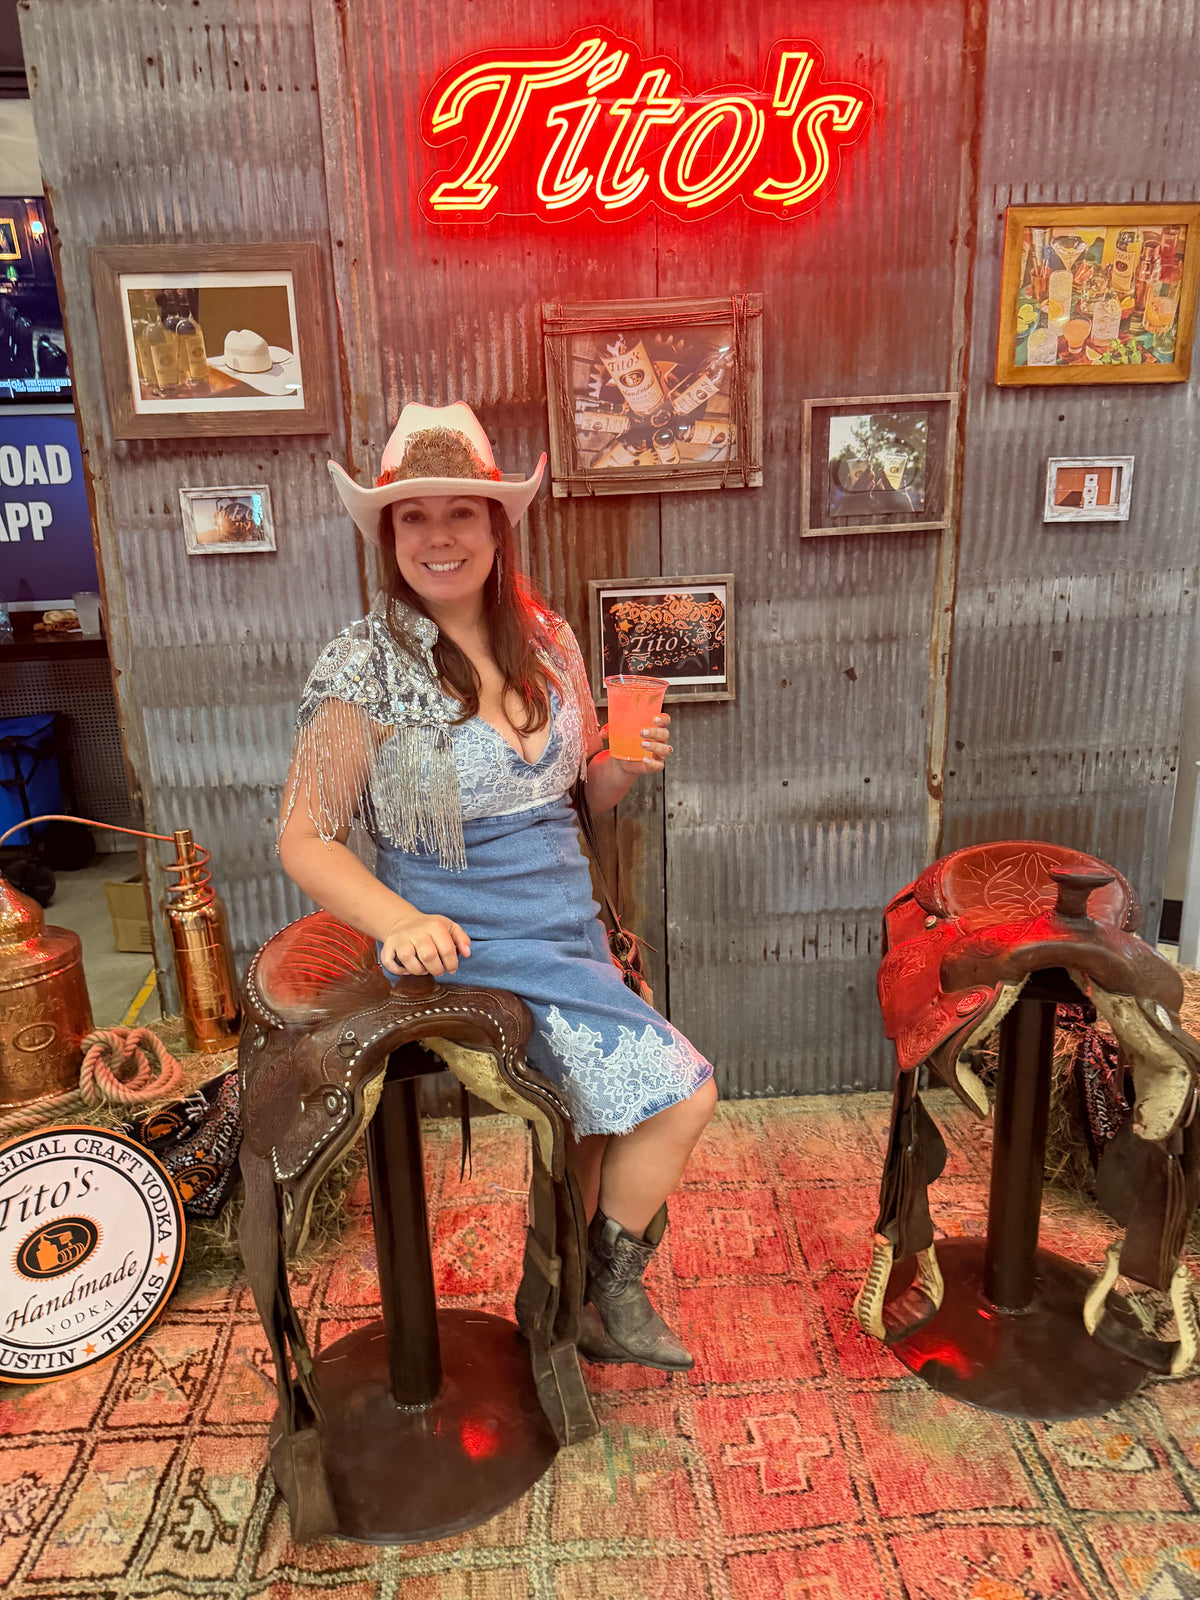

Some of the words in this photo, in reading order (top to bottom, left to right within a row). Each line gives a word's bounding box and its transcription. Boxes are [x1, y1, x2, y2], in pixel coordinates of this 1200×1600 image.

[430, 38, 863, 210] Tito's
[630, 630, 692, 653] Tito's
[211, 1115, 236, 1158] Tito's
[0, 1166, 94, 1232] Tito's
[74, 1137, 143, 1174] CRAFT
[141, 1171, 172, 1244] VODKA
[5, 1250, 138, 1334] Handmade
[45, 1299, 115, 1335] VODKA
[101, 1274, 164, 1345] TEXAS
